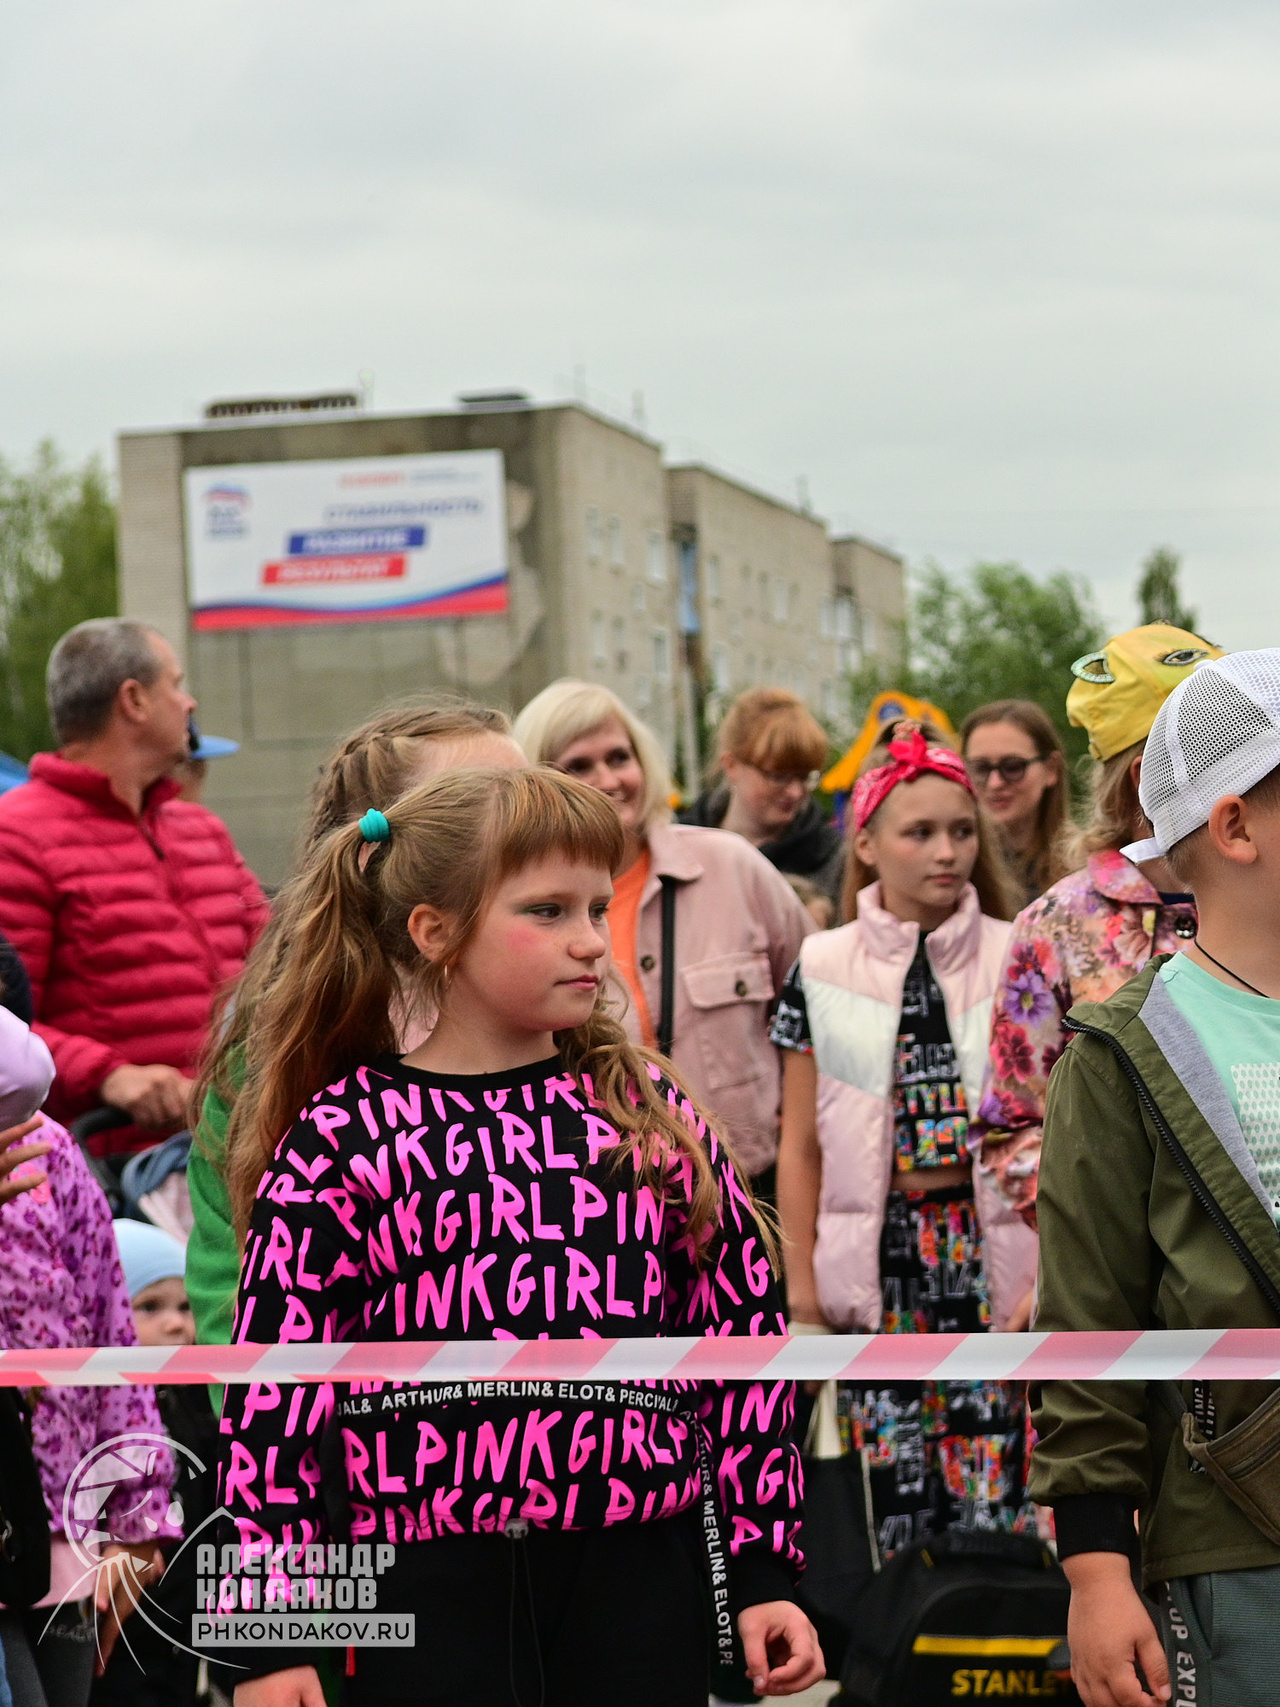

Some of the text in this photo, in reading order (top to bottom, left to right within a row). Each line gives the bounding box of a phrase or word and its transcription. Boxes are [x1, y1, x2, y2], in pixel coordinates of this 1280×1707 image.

[467, 1381, 554, 1399] MERLIN&
[558, 1384, 615, 1403] ELOT&
[951, 1668, 1062, 1697] STANLE
